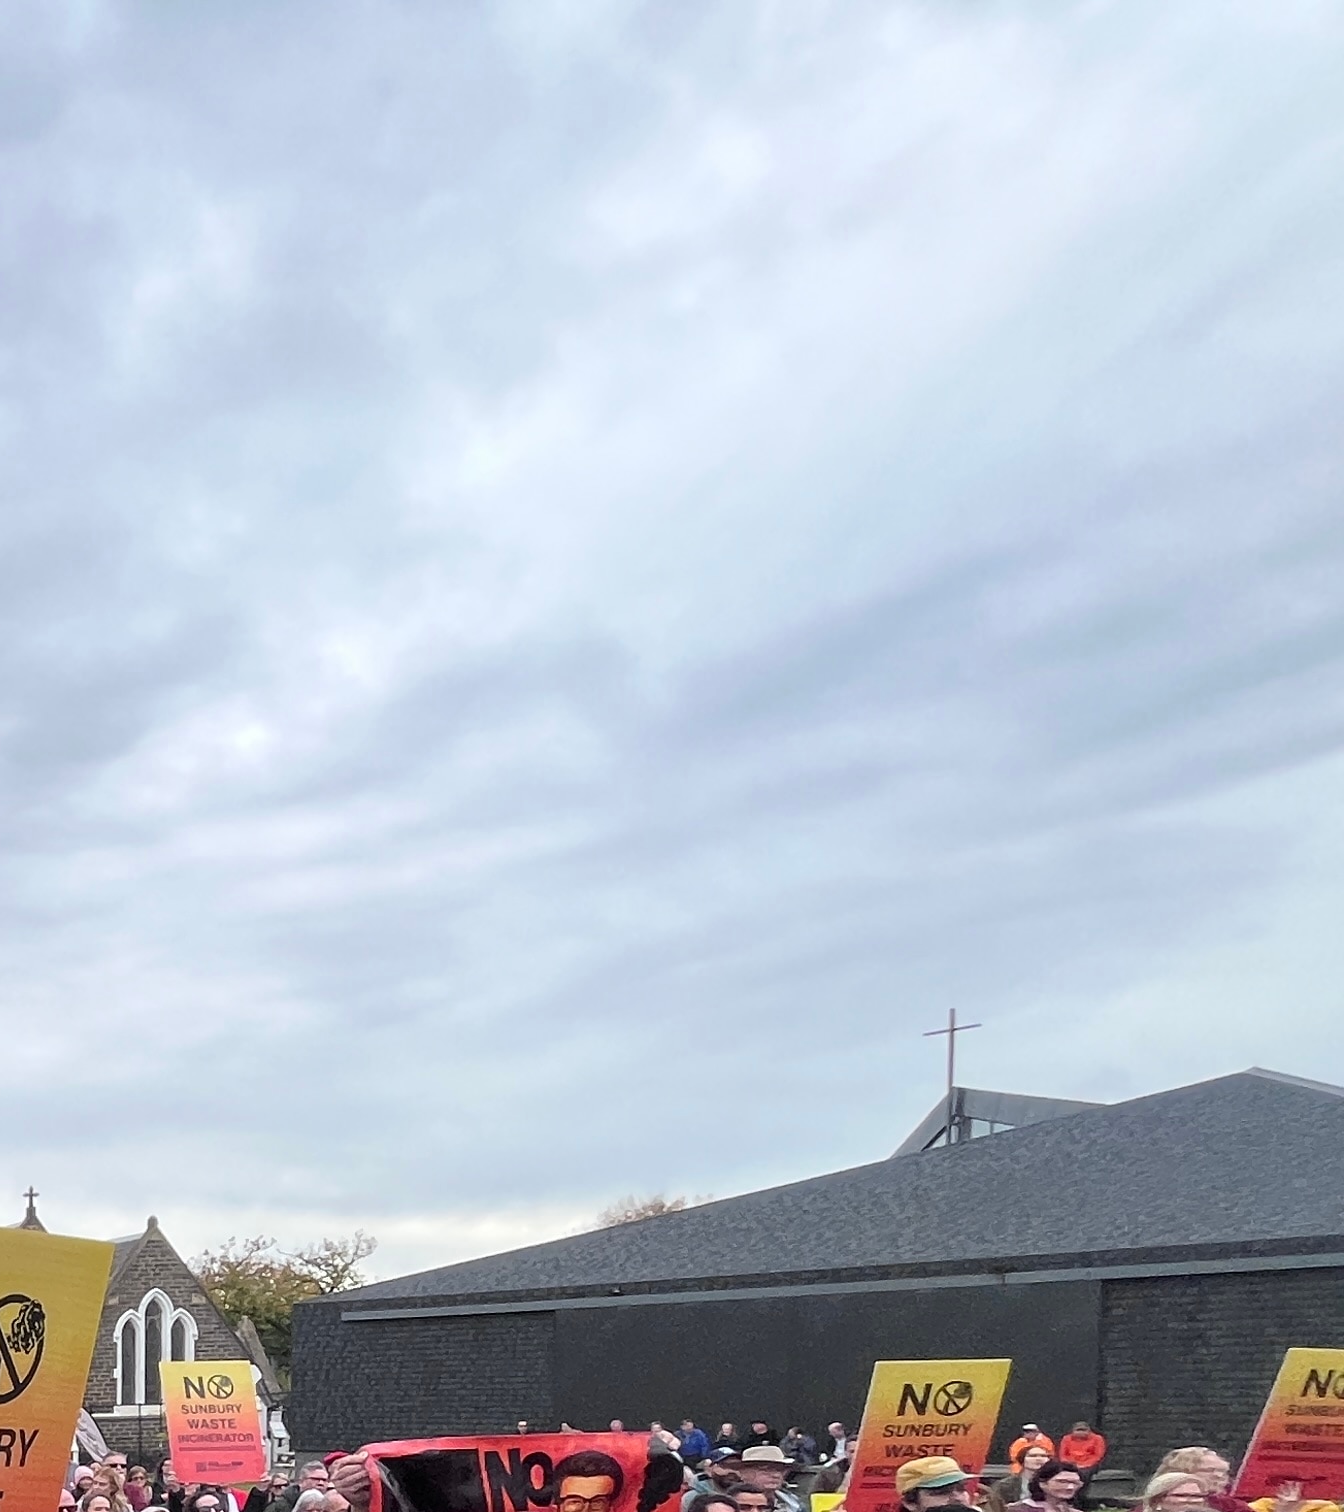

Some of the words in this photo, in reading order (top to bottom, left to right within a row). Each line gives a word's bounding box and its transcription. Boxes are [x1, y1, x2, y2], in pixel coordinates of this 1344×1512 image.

[181, 1404, 242, 1415] SUNBURY
[187, 1419, 237, 1429] WASTE
[883, 1423, 973, 1437] SUNBURY
[885, 1444, 955, 1457] WASTE
[484, 1447, 556, 1512] NO
